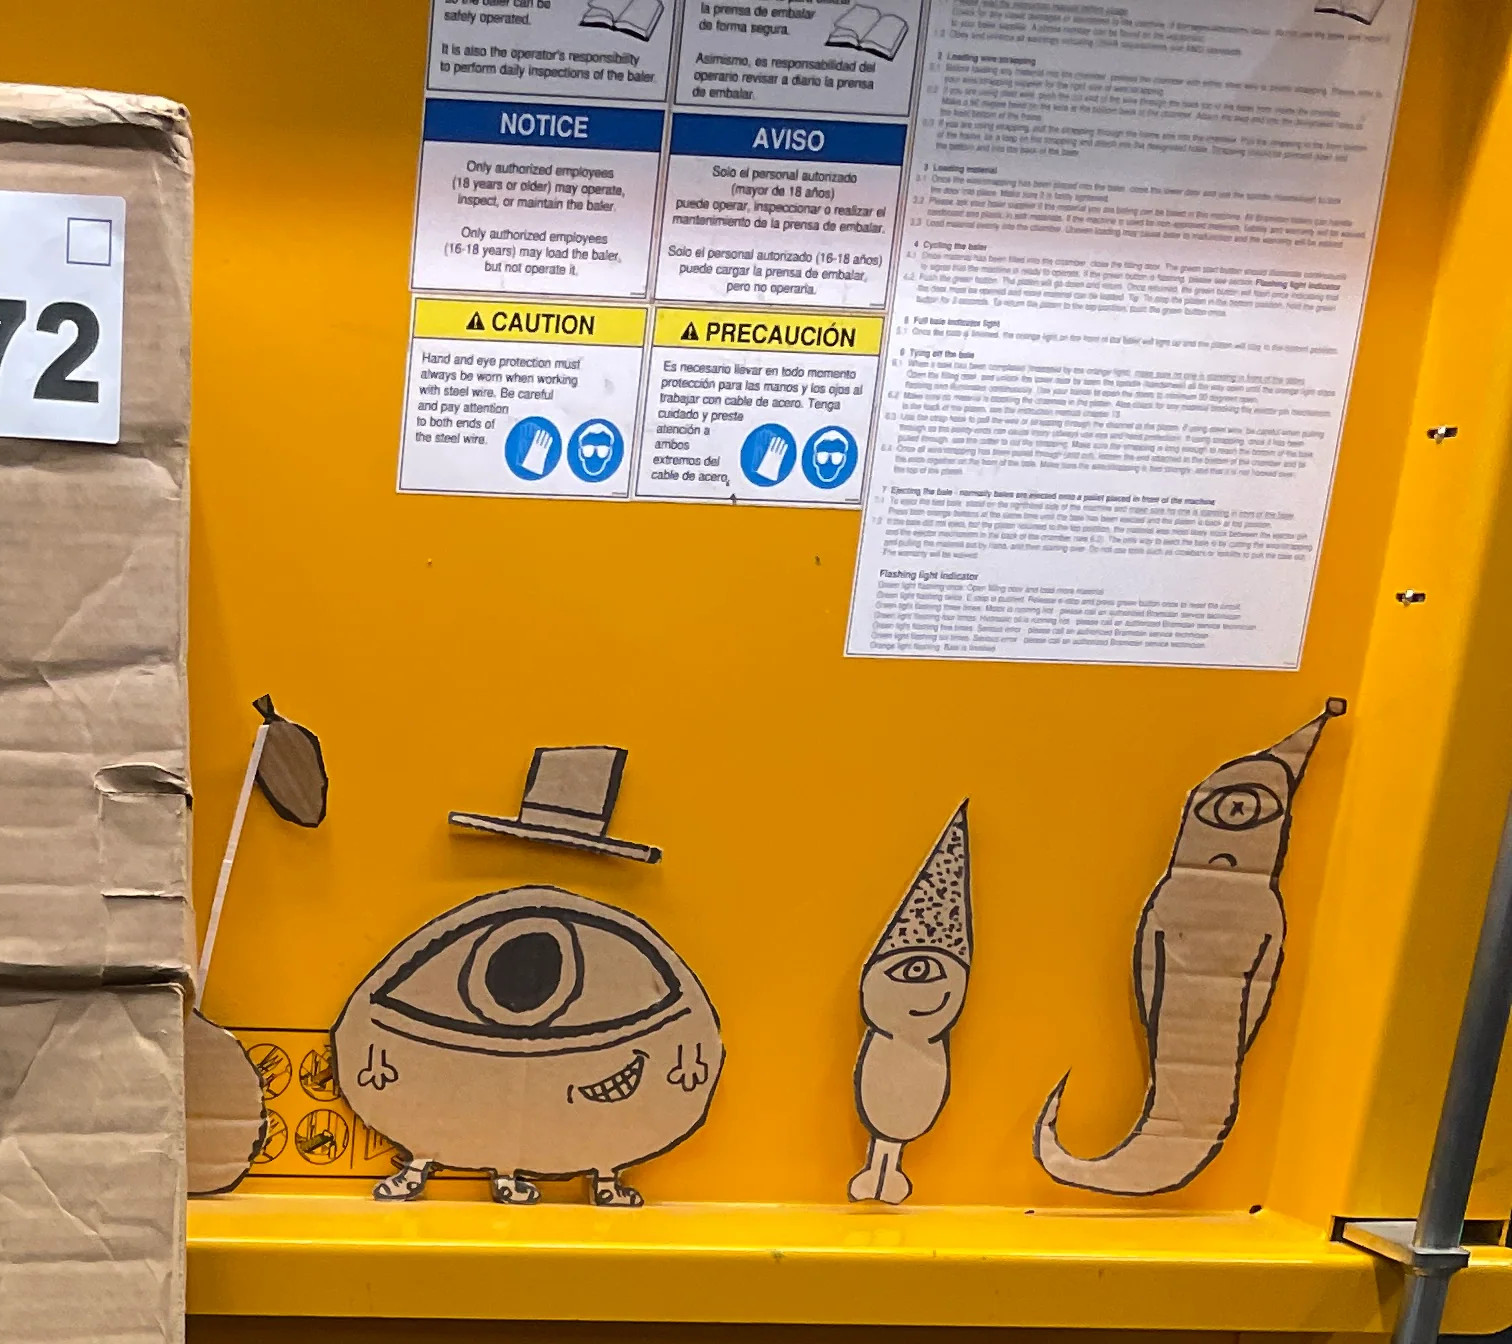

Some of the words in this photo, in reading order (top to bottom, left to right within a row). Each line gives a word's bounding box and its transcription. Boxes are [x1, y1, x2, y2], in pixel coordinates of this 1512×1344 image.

[444, 11, 476, 24] safely
[700, 2, 710, 13] la
[714, 5, 751, 18] prensa
[754, 5, 767, 16] de
[771, 7, 816, 20] embalar
[699, 19, 712, 30] de
[716, 21, 746, 32] forma
[442, 43, 448, 54] It
[452, 43, 460, 55] is
[464, 44, 486, 56] also
[491, 46, 506, 57] the
[440, 62, 450, 72] to
[454, 63, 496, 75] perform
[500, 65, 525, 79] daily
[593, 69, 604, 80] of
[607, 70, 624, 81] the
[755, 58, 767, 67] es
[771, 58, 856, 71] responsabilidad
[859, 61, 876, 72] del
[694, 71, 738, 82] operario
[742, 72, 778, 84] revisar
[824, 75, 834, 87] la
[837, 78, 873, 89] prensa
[500, 112, 588, 138] NOTICE
[752, 128, 824, 151] AVISO
[466, 160, 491, 174] Only
[495, 162, 552, 175] authorized
[556, 165, 614, 180] employees
[713, 165, 736, 177] Solo
[740, 166, 749, 178] el
[753, 169, 798, 181] personal
[802, 172, 857, 183] autorizado
[452, 177, 470, 190] (18
[473, 180, 503, 192] years
[506, 182, 517, 191] or
[521, 180, 551, 194] older)
[555, 184, 577, 196] may
[731, 183, 767, 197] (mayor
[772, 186, 785, 196] de
[790, 186, 801, 197] 18
[805, 187, 835, 200] años)
[503, 199, 514, 207] or
[517, 197, 563, 209] maintain
[567, 200, 583, 210] the
[676, 198, 709, 210] puede
[834, 205, 874, 216] realizar
[877, 207, 886, 217] el
[754, 217, 767, 228] de
[771, 218, 779, 229] la
[783, 220, 819, 231] prensa
[823, 219, 836, 231] de
[461, 227, 486, 240] Only
[490, 228, 546, 242] authorized
[550, 231, 608, 245] employees
[444, 243, 479, 256] (16-18
[482, 245, 515, 259] years)
[519, 250, 542, 260] may
[546, 247, 569, 259] load
[572, 249, 588, 259] the
[668, 245, 692, 256] Solo
[695, 246, 704, 257] el
[707, 248, 754, 260] personal
[757, 250, 812, 263] autorizado
[816, 252, 849, 265] (16-18
[853, 254, 882, 267] años)
[485, 263, 502, 272] but
[505, 264, 522, 273] not
[525, 265, 565, 275] operate
[679, 263, 712, 275] puede
[716, 266, 749, 278] cargar
[753, 265, 762, 276] la
[765, 268, 801, 280] prensa
[805, 267, 818, 278] de
[727, 282, 750, 293] pero
[754, 283, 767, 292] no
[492, 311, 595, 335] CAUTION
[706, 322, 856, 347] PRECAUCIÓN
[422, 352, 450, 365] Hand
[454, 354, 473, 366] and
[477, 358, 496, 369] eye
[499, 356, 550, 370] protection
[555, 358, 580, 369] must
[664, 361, 677, 372] Es
[680, 362, 731, 374] necesario
[735, 364, 762, 375] llevar
[766, 367, 778, 376] en
[782, 366, 804, 377] todo
[808, 368, 856, 379] momento
[421, 370, 456, 382] always
[460, 370, 473, 381] be
[506, 372, 534, 383] when
[537, 374, 577, 388] working
[661, 377, 715, 390] protección
[719, 381, 742, 392] para
[745, 379, 760, 391] las
[764, 382, 798, 393] manos
[801, 384, 807, 395] y
[811, 382, 826, 393] los
[829, 384, 850, 397] ojos
[853, 385, 863, 395] al
[419, 385, 440, 396] with
[444, 385, 468, 397] steel
[501, 387, 514, 398] Be
[518, 388, 553, 400] careful
[418, 401, 438, 411] and
[441, 404, 460, 414] pay
[464, 402, 509, 414] attention
[660, 392, 699, 406] trabajar
[702, 396, 721, 404] con
[725, 395, 752, 406] cable
[756, 396, 768, 407] de
[808, 398, 840, 412] Tenga
[417, 416, 426, 427] to
[430, 417, 452, 428] both
[457, 418, 481, 429] ends
[485, 419, 495, 430] of
[658, 408, 698, 420] cuidado
[702, 412, 708, 422] y
[711, 411, 743, 422] preste
[416, 432, 432, 442] the
[435, 433, 460, 443] steel
[657, 423, 700, 435] atención
[704, 427, 710, 435] a
[655, 439, 689, 450] ambos
[653, 455, 700, 466] extremos
[704, 455, 719, 467] del
[651, 470, 679, 480] cable
[683, 471, 696, 481] de
